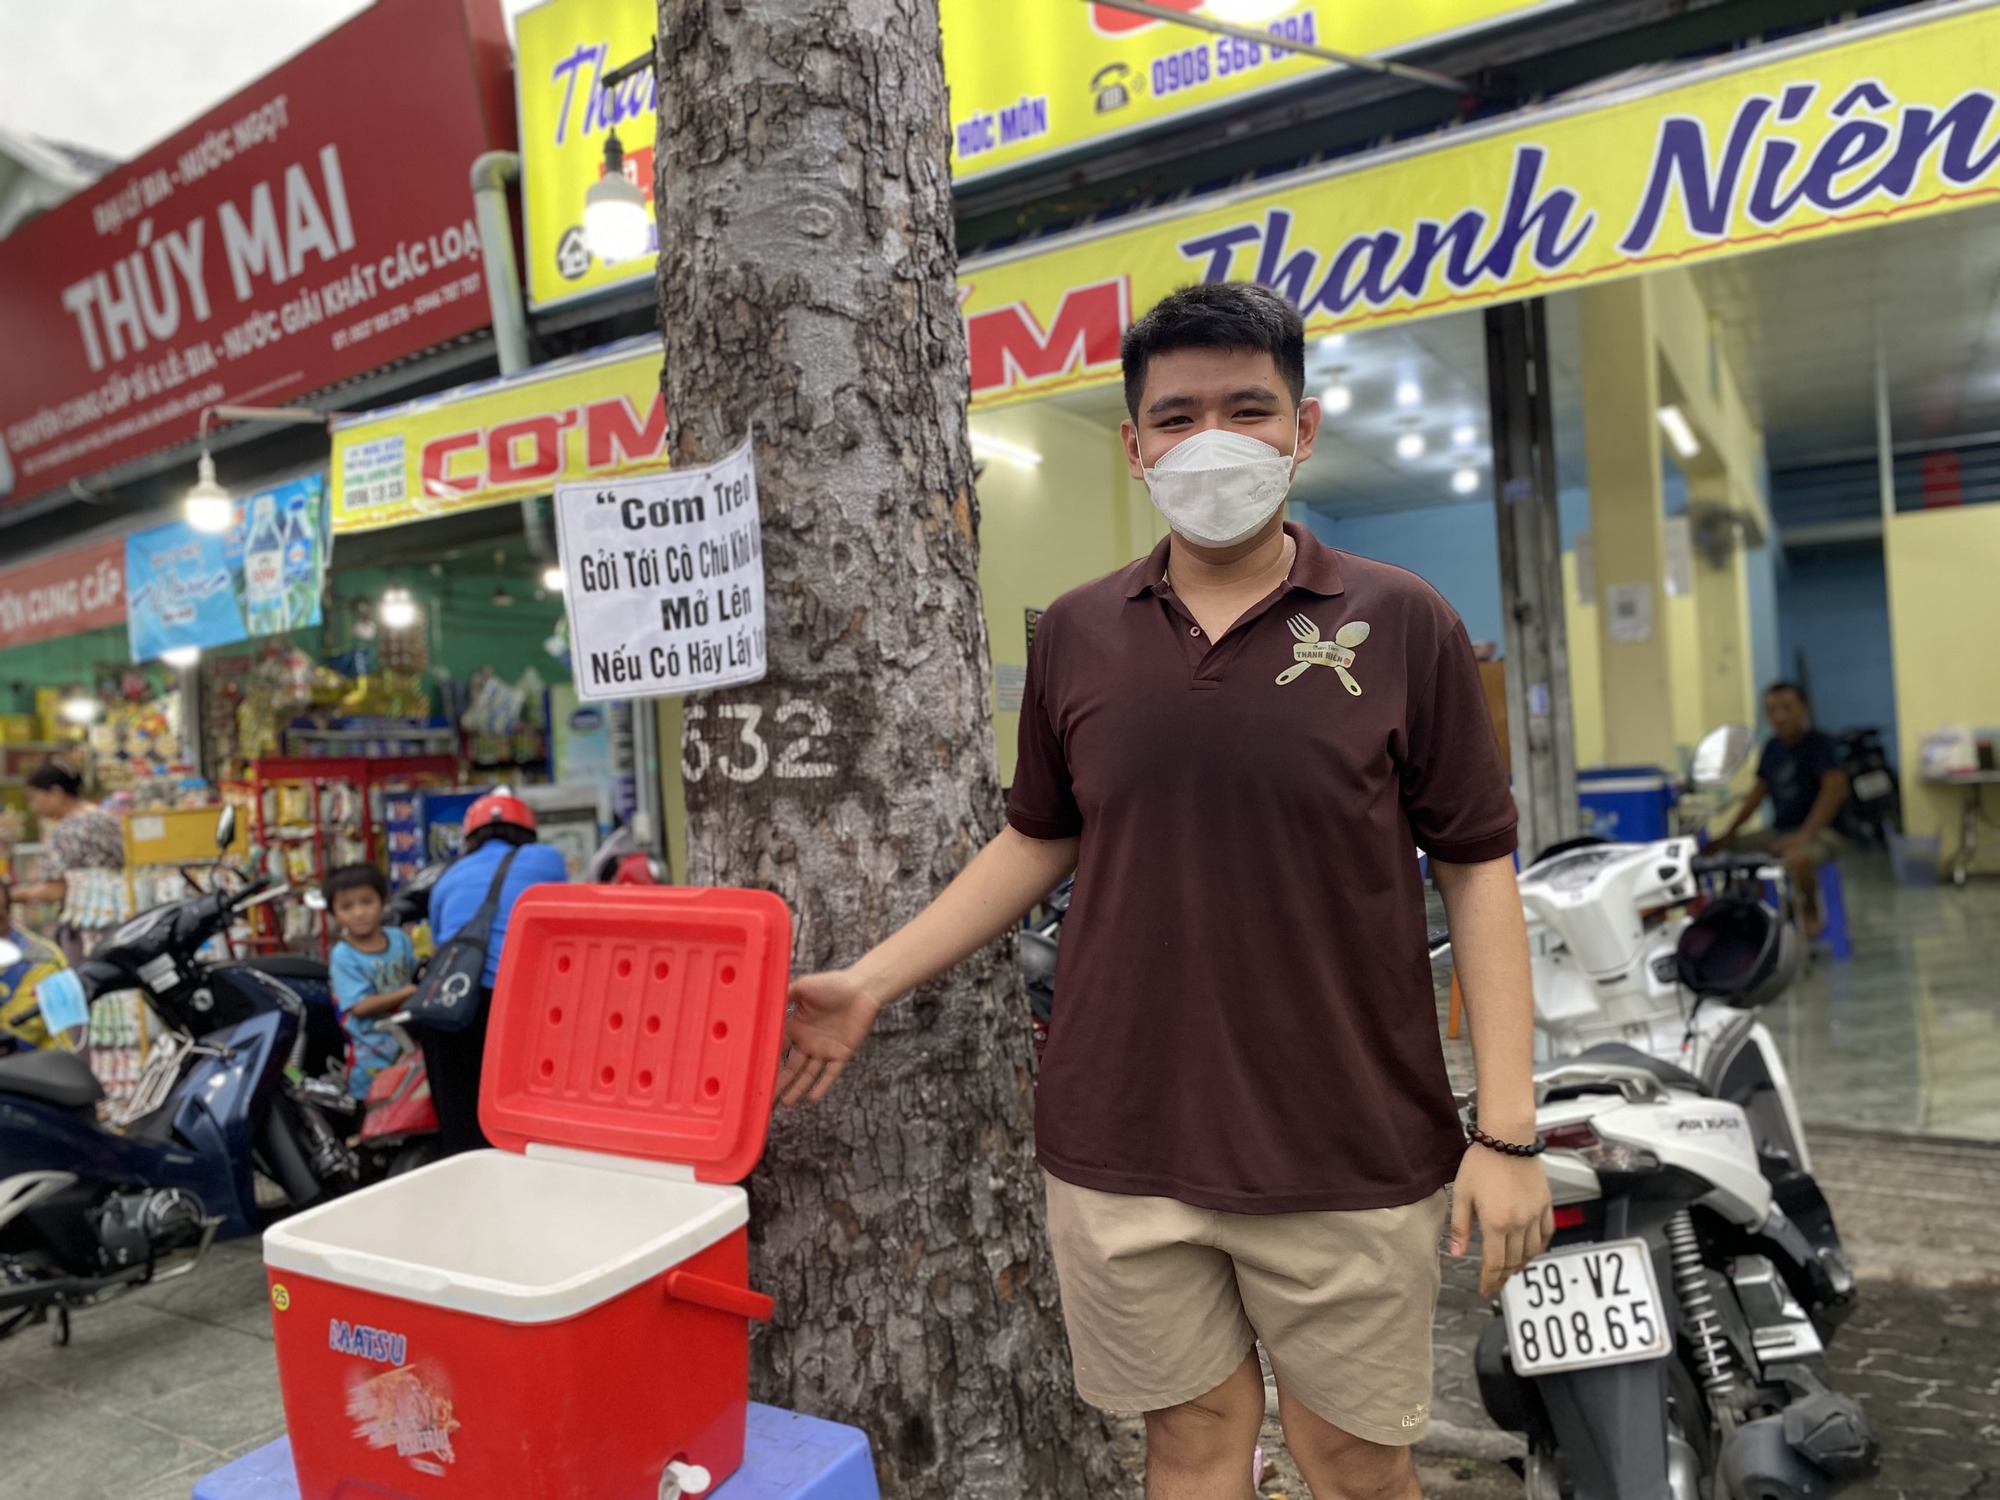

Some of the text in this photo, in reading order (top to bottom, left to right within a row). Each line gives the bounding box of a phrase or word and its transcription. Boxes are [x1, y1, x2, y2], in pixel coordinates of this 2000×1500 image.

[1152, 45, 1210, 96] 0908
[957, 96, 1046, 159] HÓC MÔN
[1180, 82, 2000, 321] Thanh Niên
[61, 142, 355, 373] THÚY MAI
[222, 308, 282, 361] NƯỚC
[280, 286, 324, 335] GIẢI
[321, 262, 378, 319] KHÁT
[378, 240, 430, 291] CÁC
[428, 218, 483, 269] LOẠ
[421, 388, 669, 499] CƠM
[580, 548, 619, 593] Gởi
[624, 548, 660, 590] Tới
[665, 542, 694, 584] Cô
[699, 534, 729, 580] Chú
[660, 583, 752, 632] Mở Lên
[591, 643, 643, 685] Nếu
[649, 643, 681, 679] Có
[687, 639, 723, 675] Hãy
[1523, 1252, 1631, 1309] 59-V2
[329, 1319, 407, 1367] MATSU
[1519, 1300, 1656, 1364] 808.65
